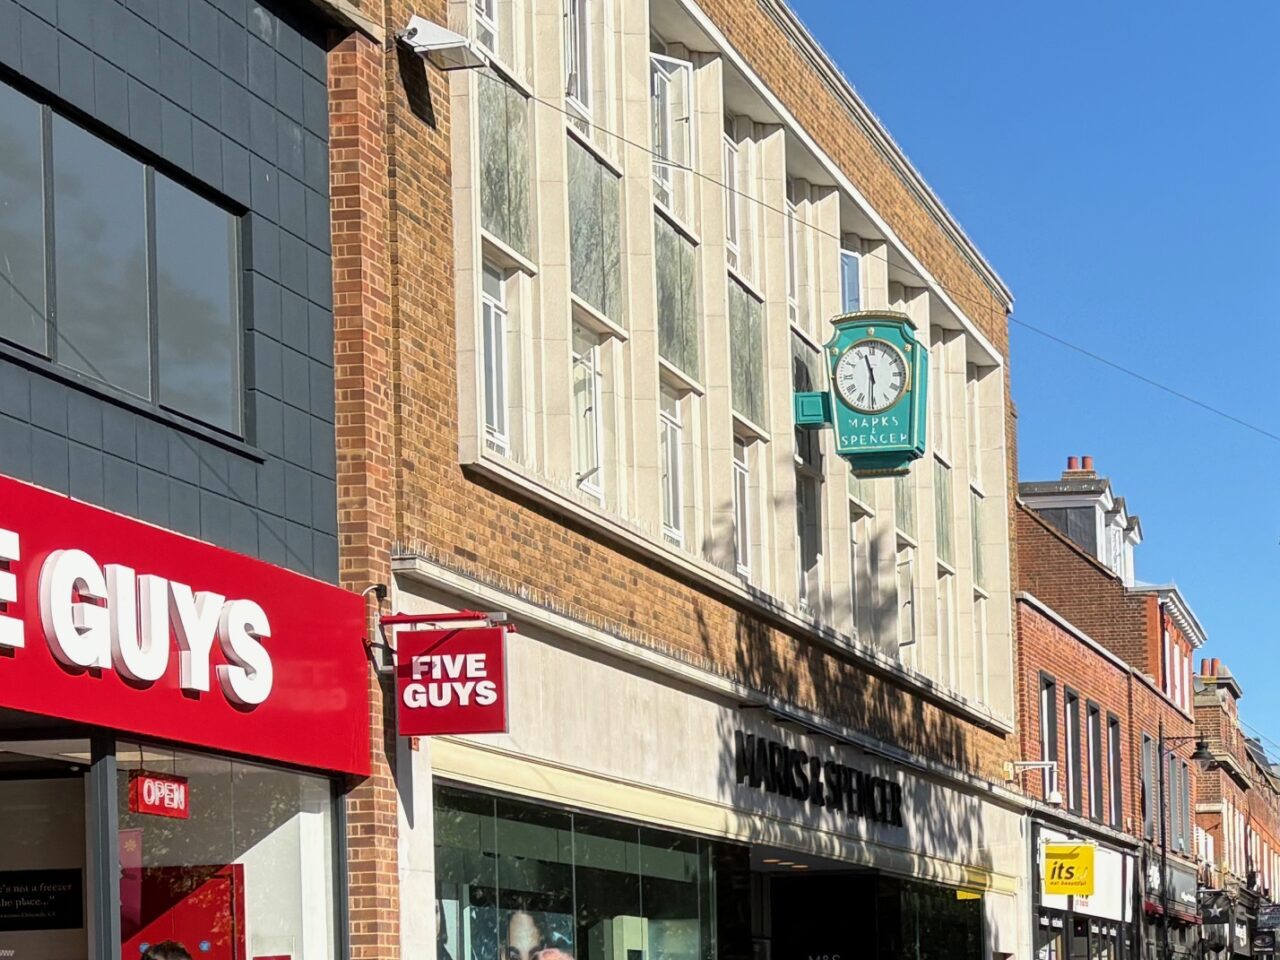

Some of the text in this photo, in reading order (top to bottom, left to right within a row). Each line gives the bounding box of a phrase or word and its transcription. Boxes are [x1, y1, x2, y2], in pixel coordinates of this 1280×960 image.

[849, 416, 899, 428] MARKS
[841, 433, 908, 446] SPENCER
[38, 548, 273, 705] GUYS
[412, 653, 487, 680] FIVE
[402, 680, 498, 709] GUYS
[143, 778, 185, 810] OPEN
